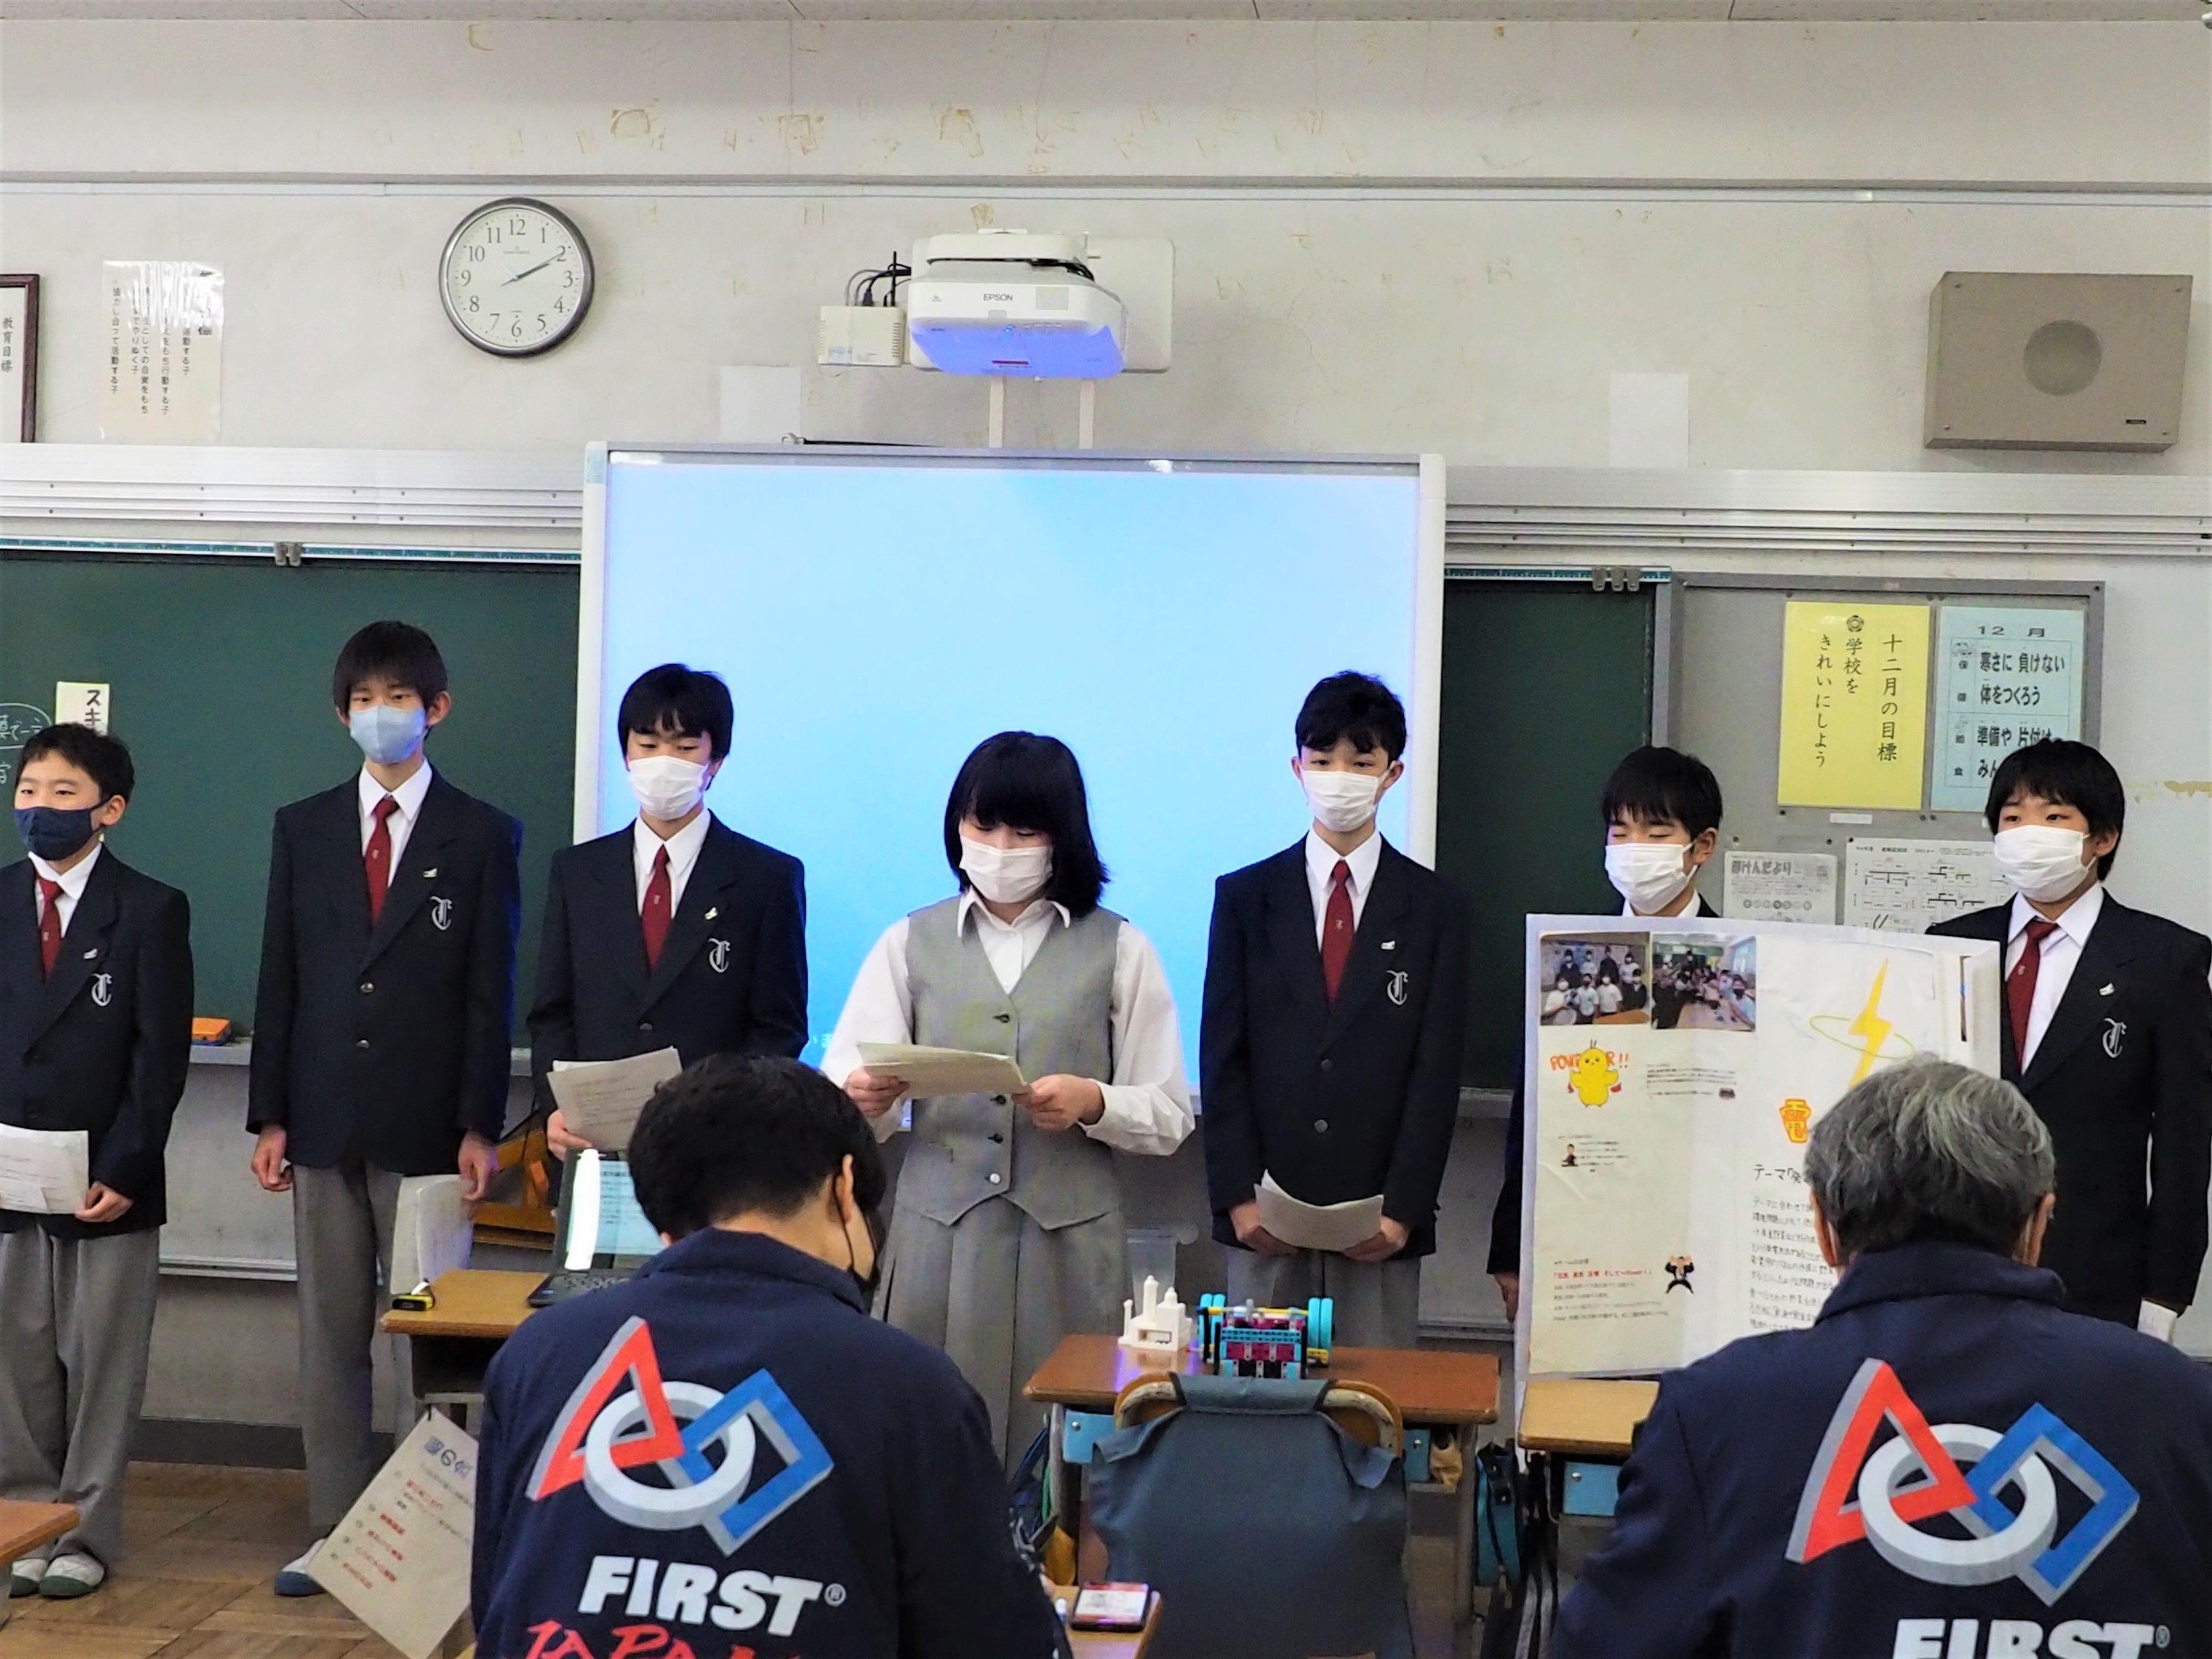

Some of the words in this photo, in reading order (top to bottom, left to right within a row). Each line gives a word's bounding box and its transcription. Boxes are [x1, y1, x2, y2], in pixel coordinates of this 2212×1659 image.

[487, 227, 501, 243] 11
[510, 219, 526, 235] 12
[541, 227, 546, 243] 1
[468, 246, 485, 262] 10
[556, 246, 567, 261] 2
[461, 269, 471, 287] 9
[563, 271, 573, 288] 3
[470, 295, 479, 312] 8
[554, 296, 564, 313] 4
[489, 313, 500, 330] 7
[511, 319, 522, 337] 6
[537, 314, 546, 332] 5
[2028, 627, 2045, 638] 月
[1842, 638, 1863, 694] 学校を
[1980, 652, 2013, 672] 寒さに
[2019, 653, 2065, 673] 負けない
[1814, 633, 1833, 768] きれいにしよう
[1877, 634, 1903, 762] 十二月の目標
[1981, 684, 2041, 706] 体をつくろう
[1977, 725, 2012, 747] 準備や
[1754, 1164, 1810, 1184] テーマ「発
[503, 1620, 807, 1659] JAP
